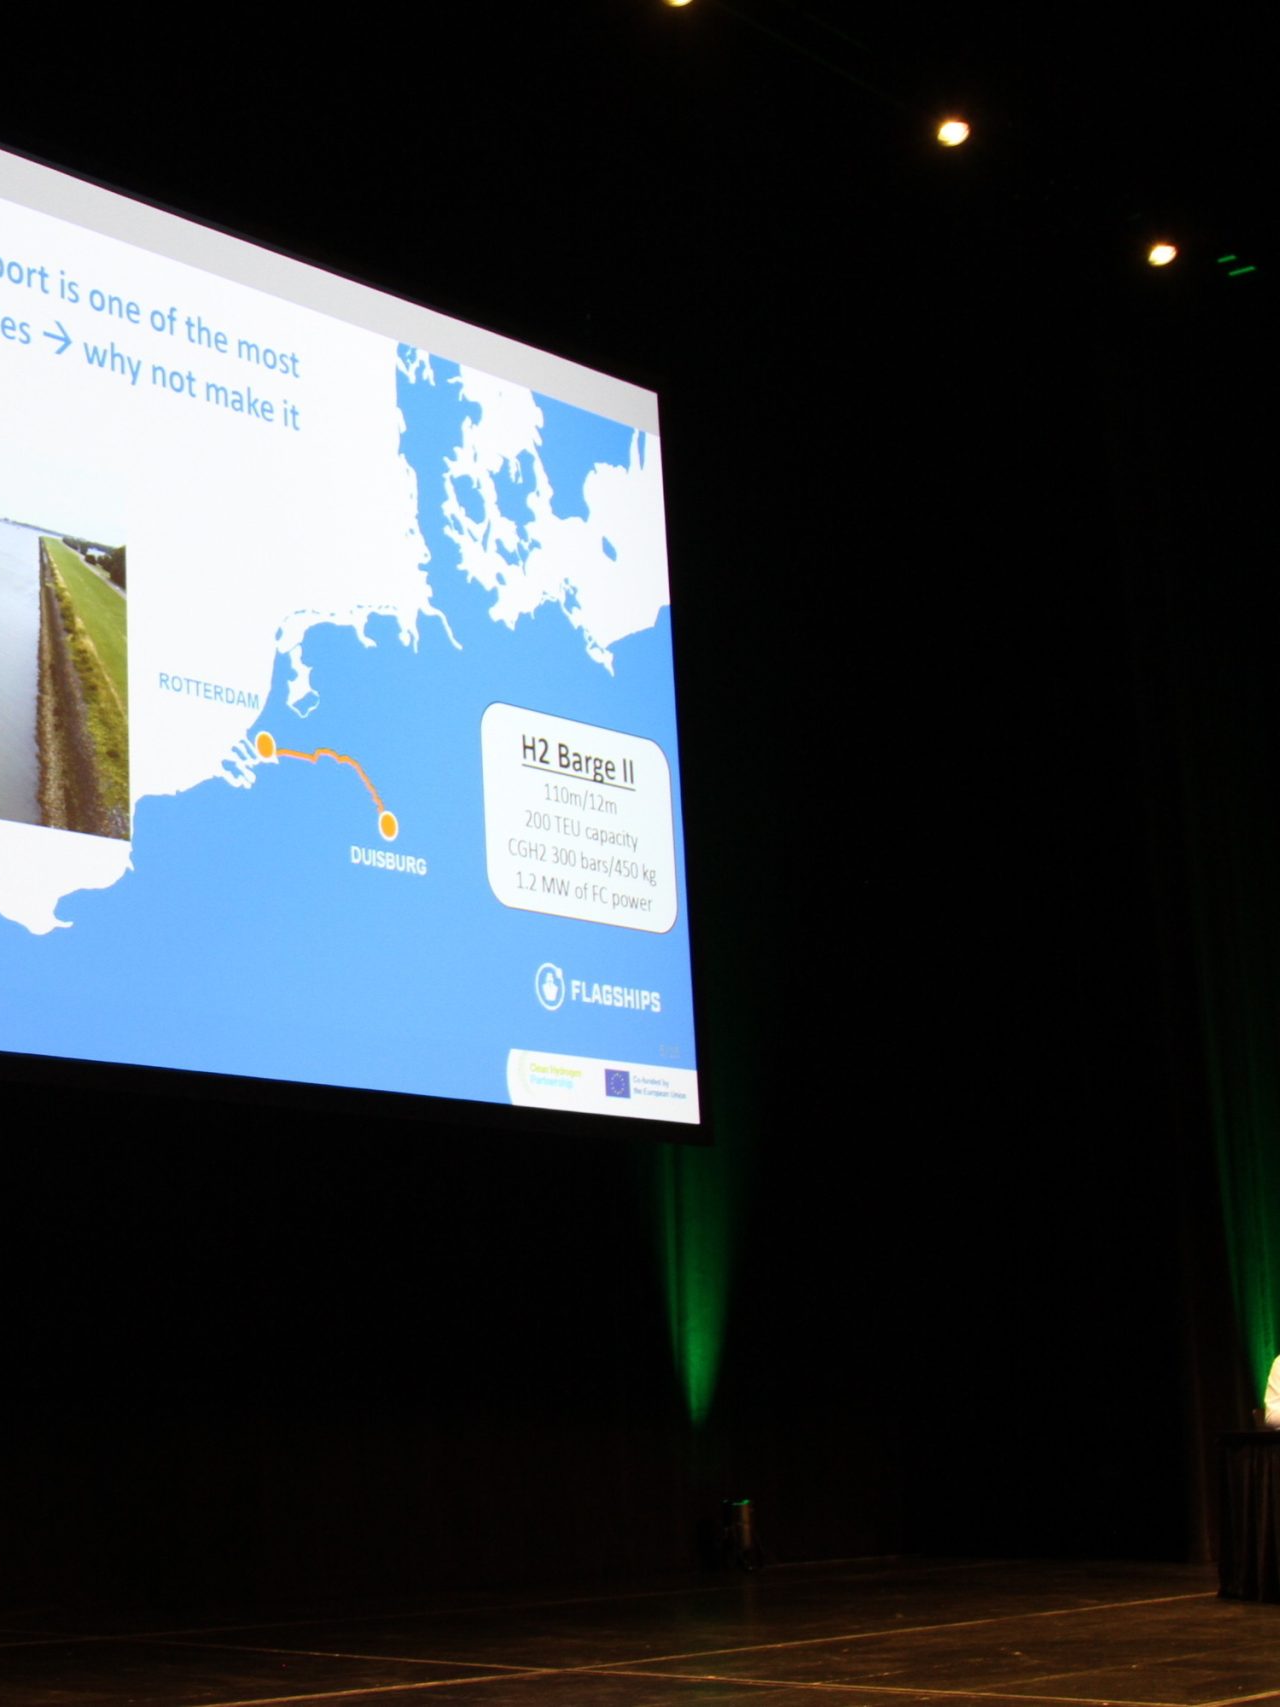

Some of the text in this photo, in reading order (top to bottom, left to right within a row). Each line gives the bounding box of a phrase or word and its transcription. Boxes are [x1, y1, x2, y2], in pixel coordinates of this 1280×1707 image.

[60, 270, 80, 303] is
[89, 288, 141, 324] one
[150, 307, 178, 336] of
[185, 317, 228, 353] the
[238, 337, 301, 379] most
[83, 341, 142, 385] why
[152, 362, 197, 398] not
[206, 380, 275, 422] make
[283, 400, 301, 431] it
[159, 672, 260, 710] ROTTERDAM
[522, 734, 550, 764] H2
[558, 743, 616, 783] Barge
[545, 783, 617, 815] 110m/12m
[525, 809, 638, 853] 200 TEU capacity
[350, 846, 427, 875] DUISBURG
[508, 838, 657, 887] CGH2 300 bars/450 kg
[516, 871, 653, 913] 1.2 MW of FC power
[571, 979, 662, 1013] FLAGSHIPS
